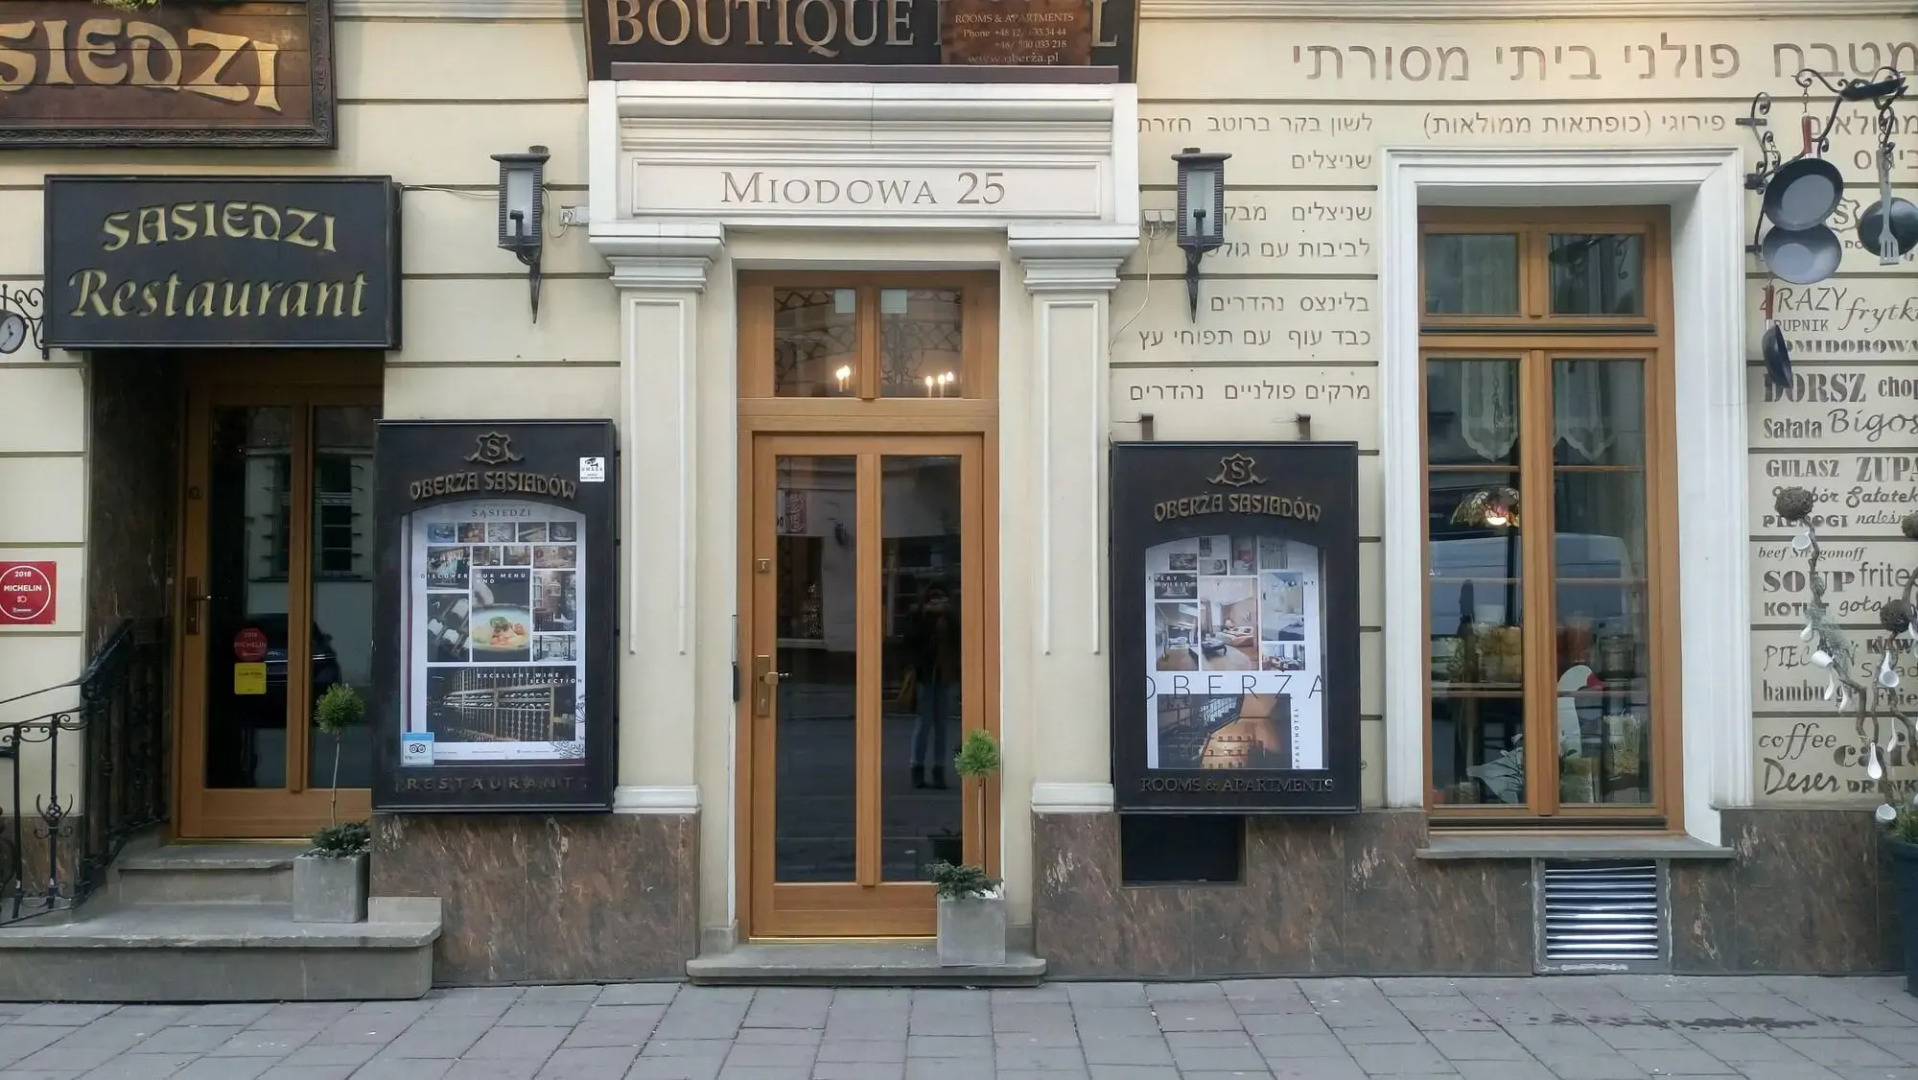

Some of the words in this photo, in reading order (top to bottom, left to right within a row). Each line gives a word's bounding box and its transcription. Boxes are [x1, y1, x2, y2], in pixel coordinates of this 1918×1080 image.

[955, 13, 992, 23] ROOMS
[994, 14, 1002, 23] &
[1004, 12, 1074, 23] APARTMENTS
[606, 0, 915, 57] BOUTIQUE
[963, 28, 990, 38] Phone
[1052, 39, 1067, 48] 218
[1293, 45, 1469, 81] מסורתי
[1496, 45, 1603, 81] ביתי
[1624, 32, 1740, 80] פולני
[1207, 116, 1271, 133] ברוטב
[1280, 116, 1322, 134] בקר
[1331, 112, 1373, 137] לשון
[1661, 113, 1726, 133] פירוגי
[1291, 149, 1373, 170] שניצלים
[721, 171, 938, 205] MIODOWA
[956, 171, 1005, 205] 25
[1291, 201, 1373, 222] שניצלים
[1260, 242, 1289, 258] עם
[1298, 237, 1371, 258] לביבות
[68, 268, 369, 319] Restaurant
[1299, 291, 1370, 312] בלינצס
[1210, 296, 1284, 312] נהדרים
[1773, 319, 1829, 332] UPNIK
[1139, 329, 1164, 351] עץ
[1173, 329, 1233, 346] תפוחי
[1243, 329, 1271, 346] עם
[1288, 330, 1323, 350] עוף
[1331, 330, 1372, 346] כבד
[1786, 339, 1918, 353] MIDOROWA
[1130, 384, 1204, 401] נהדרים
[1224, 379, 1296, 400] פולניים
[1305, 384, 1371, 404] מרקים
[1763, 418, 1822, 439] Sałata
[487, 438, 500, 458] S
[1231, 460, 1245, 480] S
[1765, 459, 1840, 478] GULASZ
[408, 470, 480, 500] OBERŻA
[484, 470, 577, 500] SĄSIADÓW
[1153, 490, 1223, 522] OBERŻA
[1228, 493, 1322, 523] SĄSIADÓW
[1757, 547, 1790, 561] beef
[14, 570, 32, 578] 2018
[3, 584, 43, 592] MICHELIN
[1758, 722, 1837, 760] coffee
[406, 776, 574, 791] RESTAURANT
[1140, 777, 1201, 793] ROOMS
[1204, 778, 1219, 792] &
[1221, 777, 1334, 793] APARTMENTS
[1762, 757, 1840, 795] Deser
